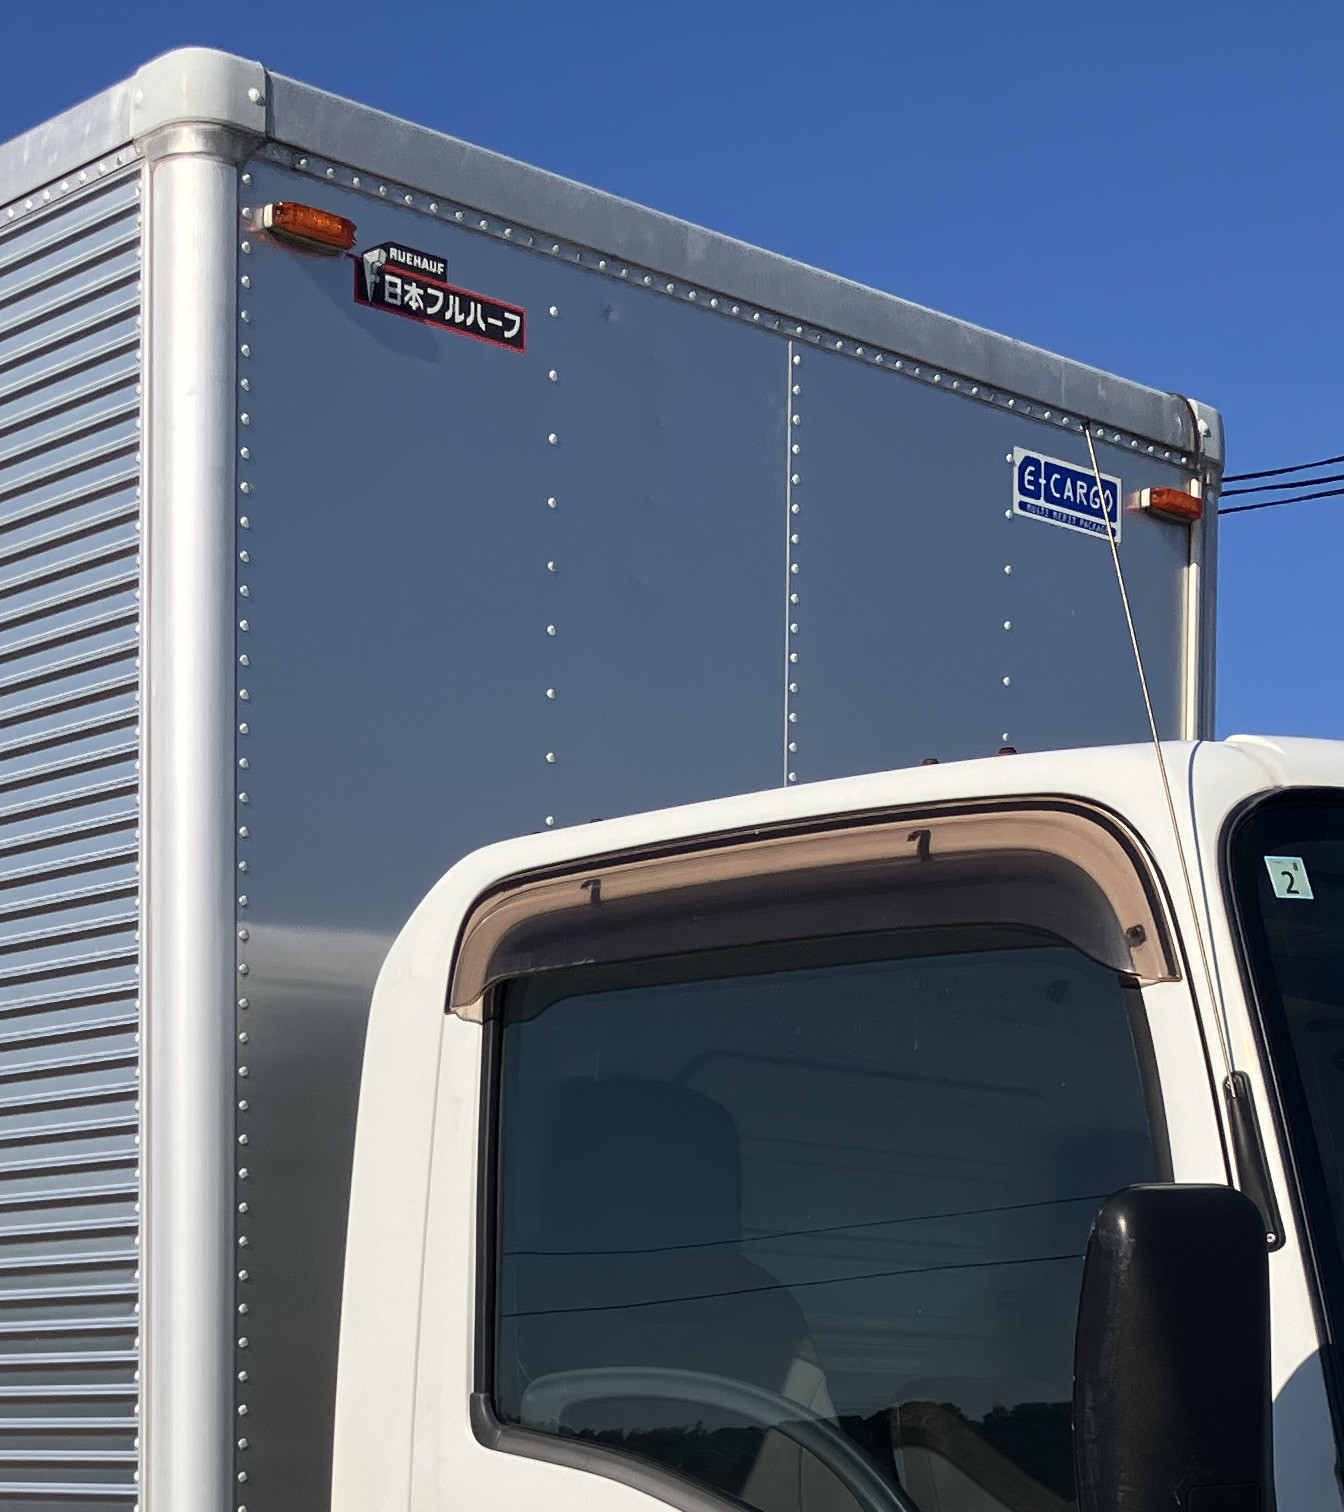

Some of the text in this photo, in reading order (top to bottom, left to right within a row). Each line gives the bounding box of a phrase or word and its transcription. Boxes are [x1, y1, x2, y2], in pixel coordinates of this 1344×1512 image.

[384, 274, 521, 339] 日本フルハーフ
[1281, 870, 1300, 895] 2
